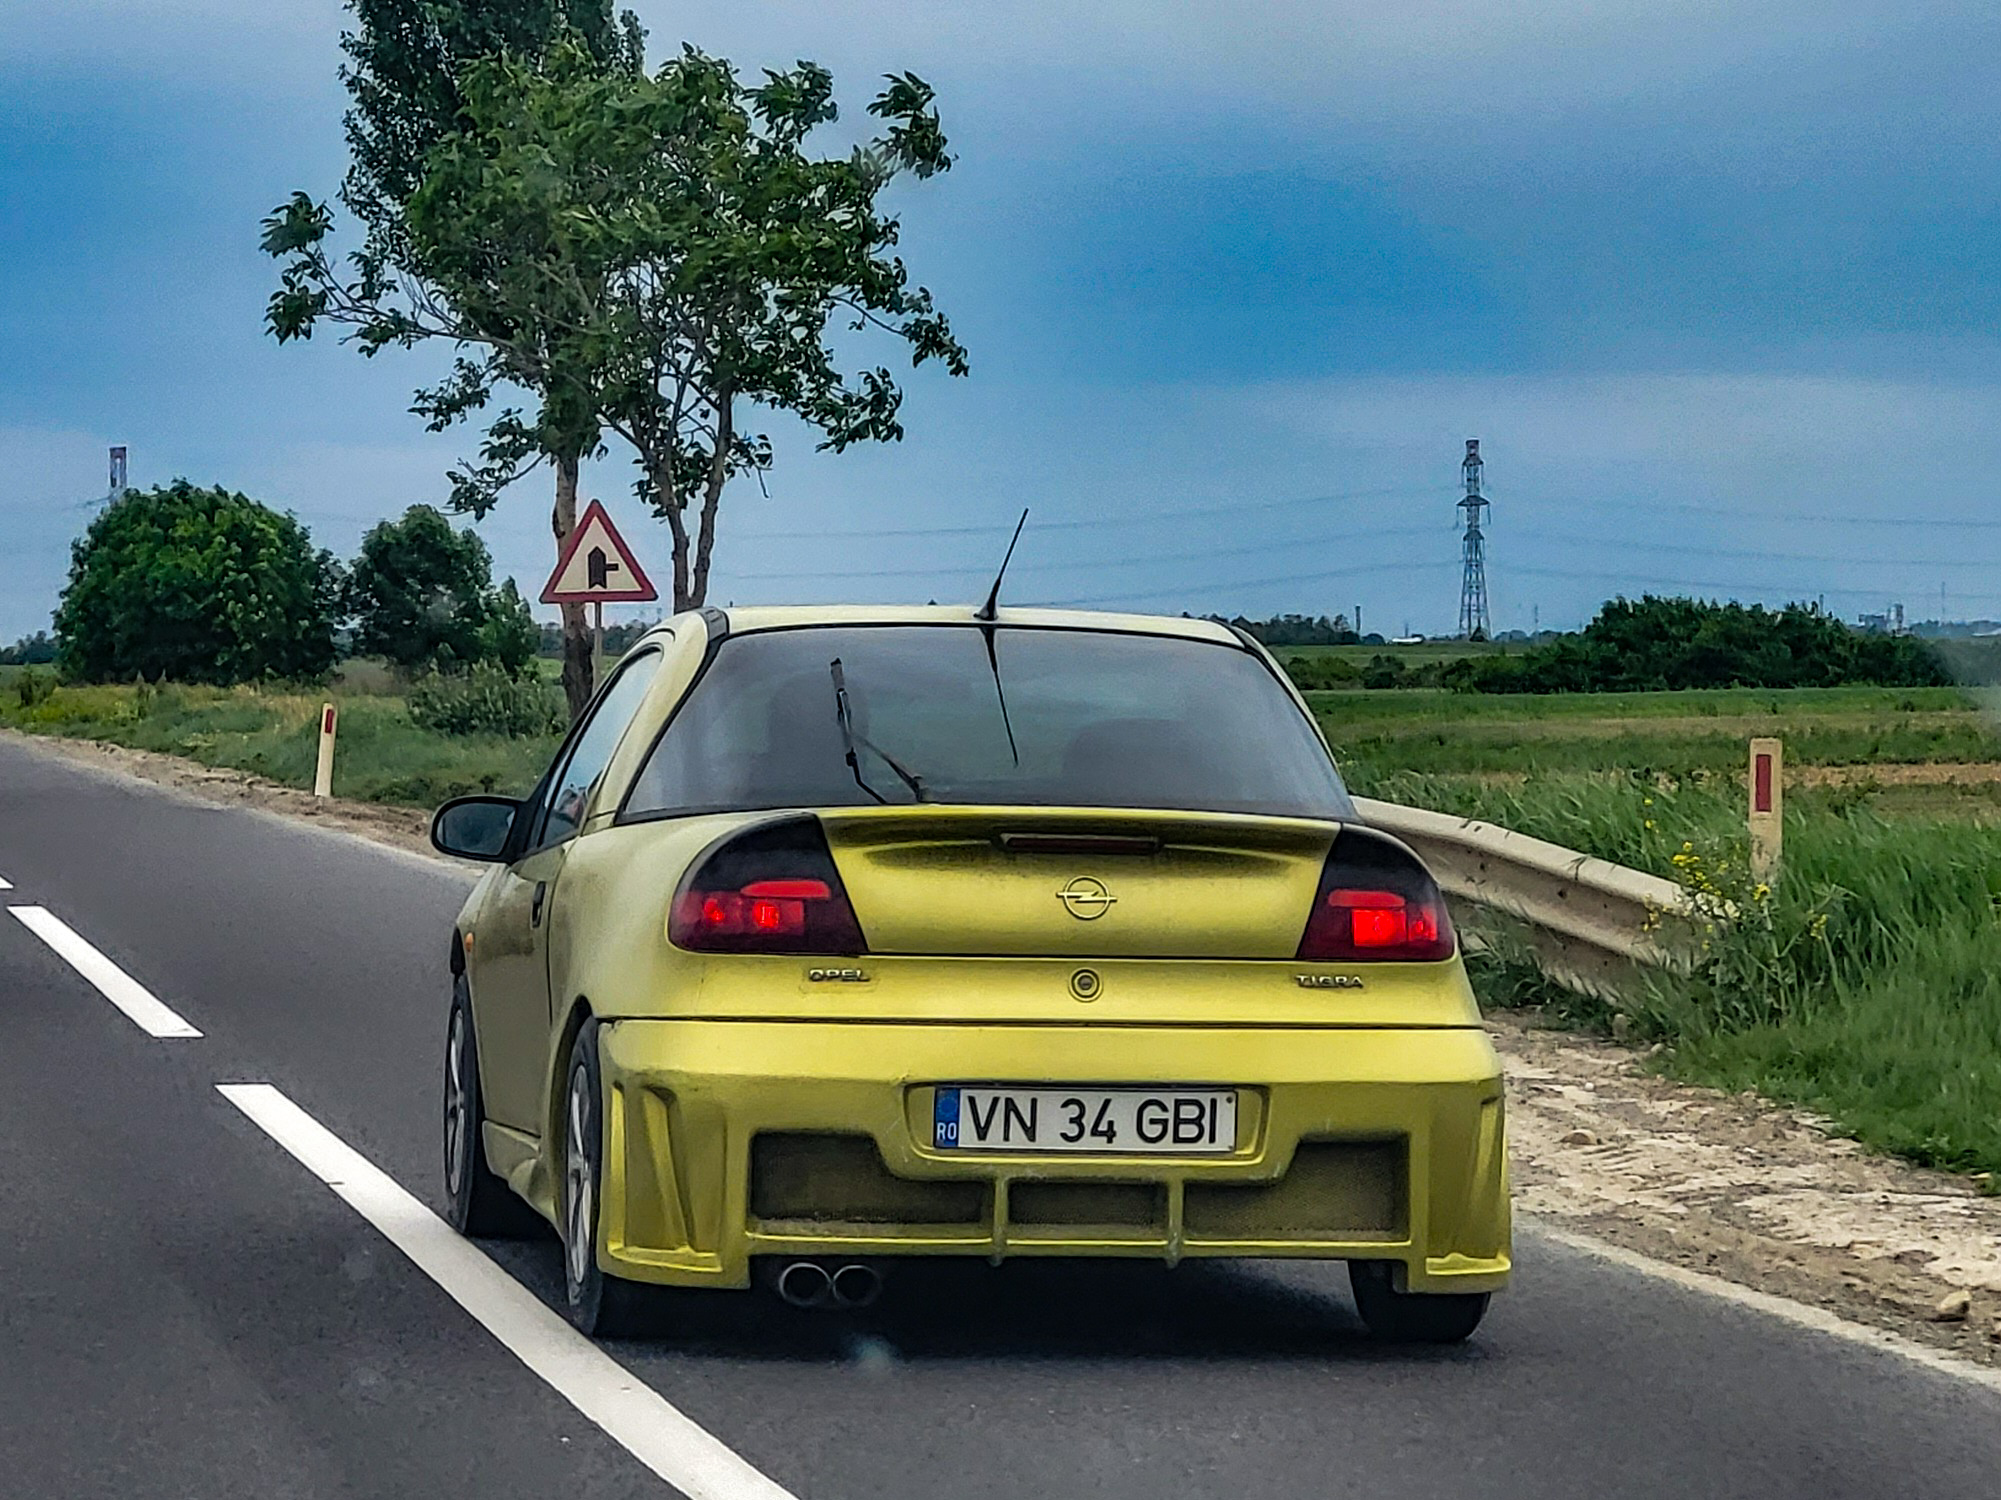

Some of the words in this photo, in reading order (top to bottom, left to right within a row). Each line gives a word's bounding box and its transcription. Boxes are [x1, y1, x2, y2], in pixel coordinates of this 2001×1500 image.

[809, 968, 870, 982] OPEL
[1295, 974, 1364, 988] TIGRA
[967, 1095, 1038, 1142] VN
[1059, 1098, 1117, 1144] 34
[1135, 1098, 1218, 1144] GBI
[936, 1122, 957, 1140] RO
